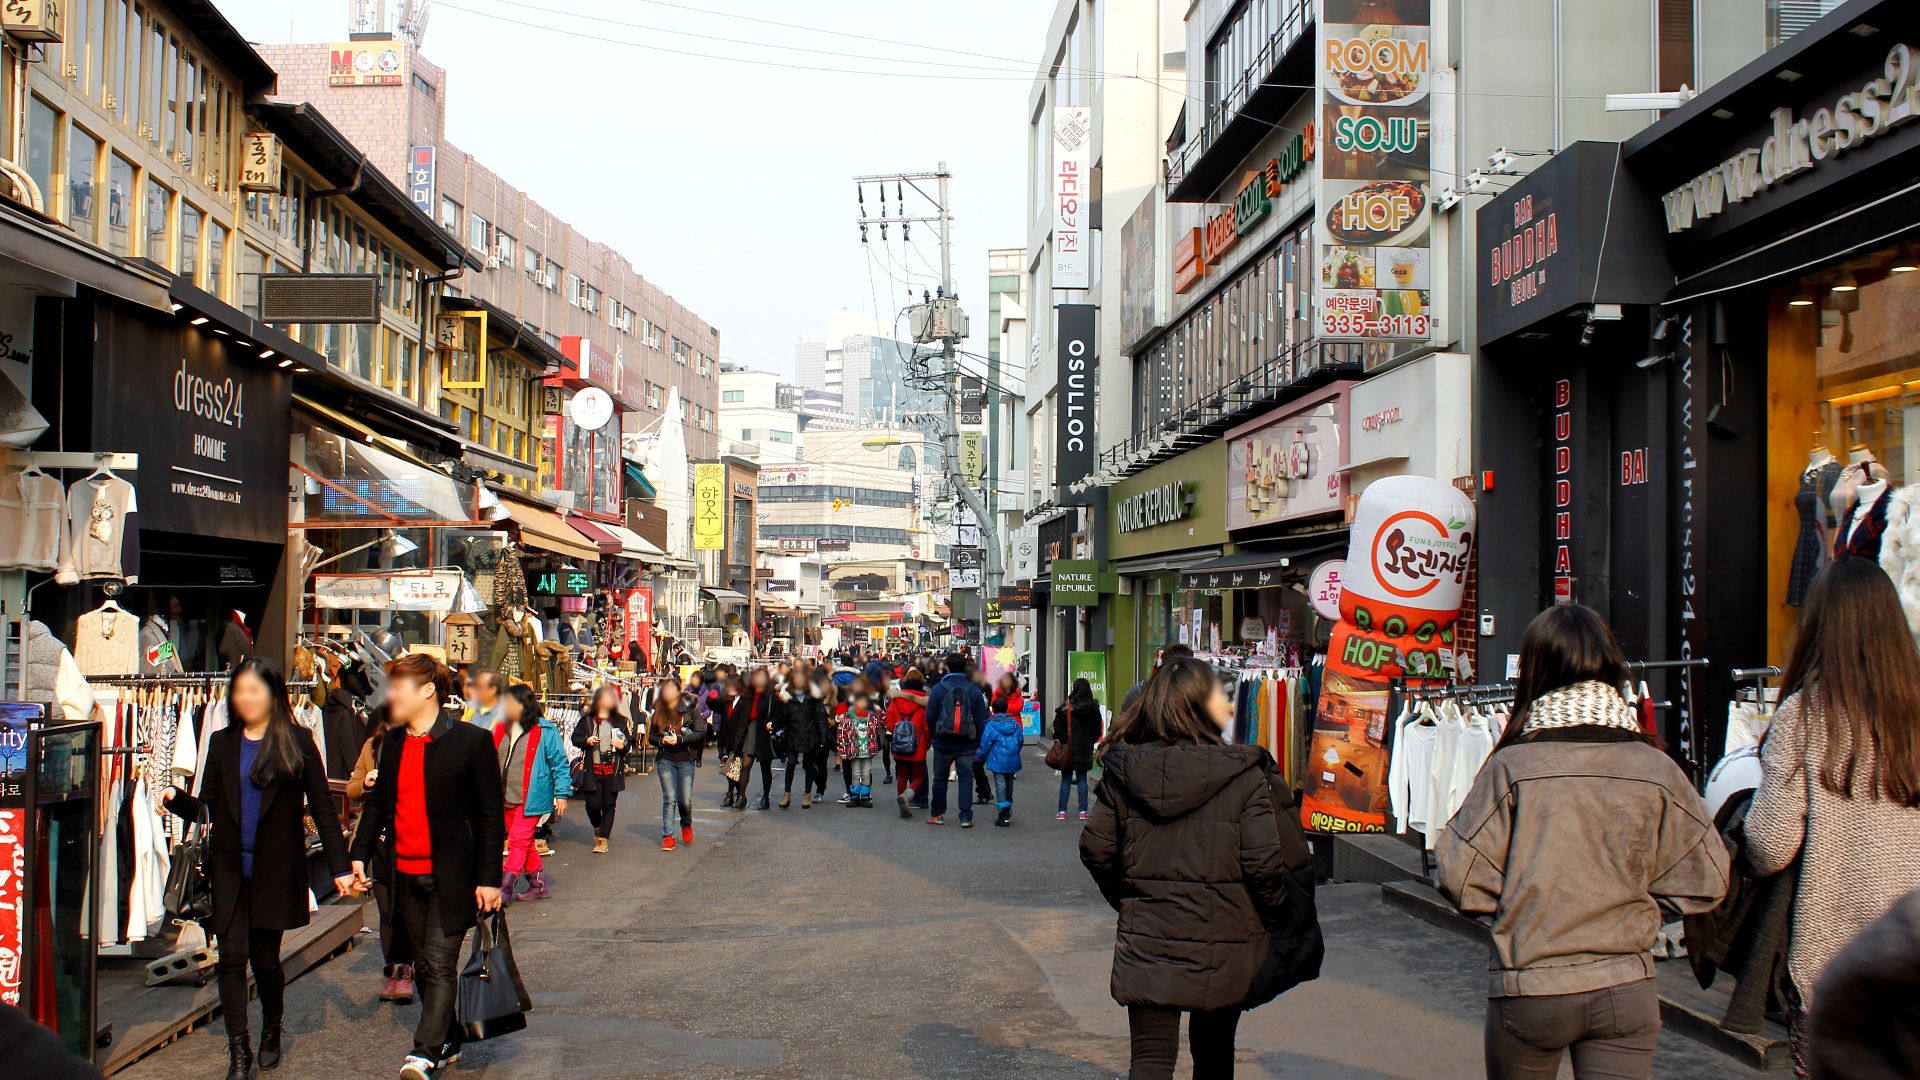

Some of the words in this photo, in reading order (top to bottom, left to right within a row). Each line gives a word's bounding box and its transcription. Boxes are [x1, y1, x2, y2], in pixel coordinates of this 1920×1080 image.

[1325, 38, 1428, 74] ROOM
[1303, 118, 1315, 161] HO
[1335, 115, 1418, 153] SOJU
[1662, 43, 1920, 233] www.dress2
[414, 168, 430, 216] 호미
[1058, 160, 1078, 252] 라디오키친
[1343, 195, 1410, 232] HOF
[1514, 195, 1533, 229] BAR
[1491, 213, 1558, 287] BUDDHA
[1325, 297, 1373, 312] 예약문의
[1511, 271, 1537, 306] SEOUL
[1325, 315, 1427, 336] 335-3113
[174, 359, 243, 429] dress24
[1067, 339, 1085, 453] OSULLOC
[194, 434, 227, 462] HOMME
[1621, 447, 1649, 485] BA
[1555, 379, 1571, 573] BUDDHA
[700, 486, 719, 526] 향수
[1117, 493, 1144, 534] NATURE
[1145, 480, 1183, 527] REPUBLIC
[703, 537, 715, 546] 2F
[1384, 528, 1472, 584] 오렌지룸
[1409, 536, 1427, 545] FUN
[1432, 541, 1458, 549] JOYFUL
[537, 573, 589, 595] 사주
[1055, 584, 1096, 592] REPUBLIC
[1058, 573, 1093, 581] NATURE
[1317, 590, 1340, 605] 고양
[1343, 636, 1394, 671] HOF
[0, 726, 28, 751] ity
